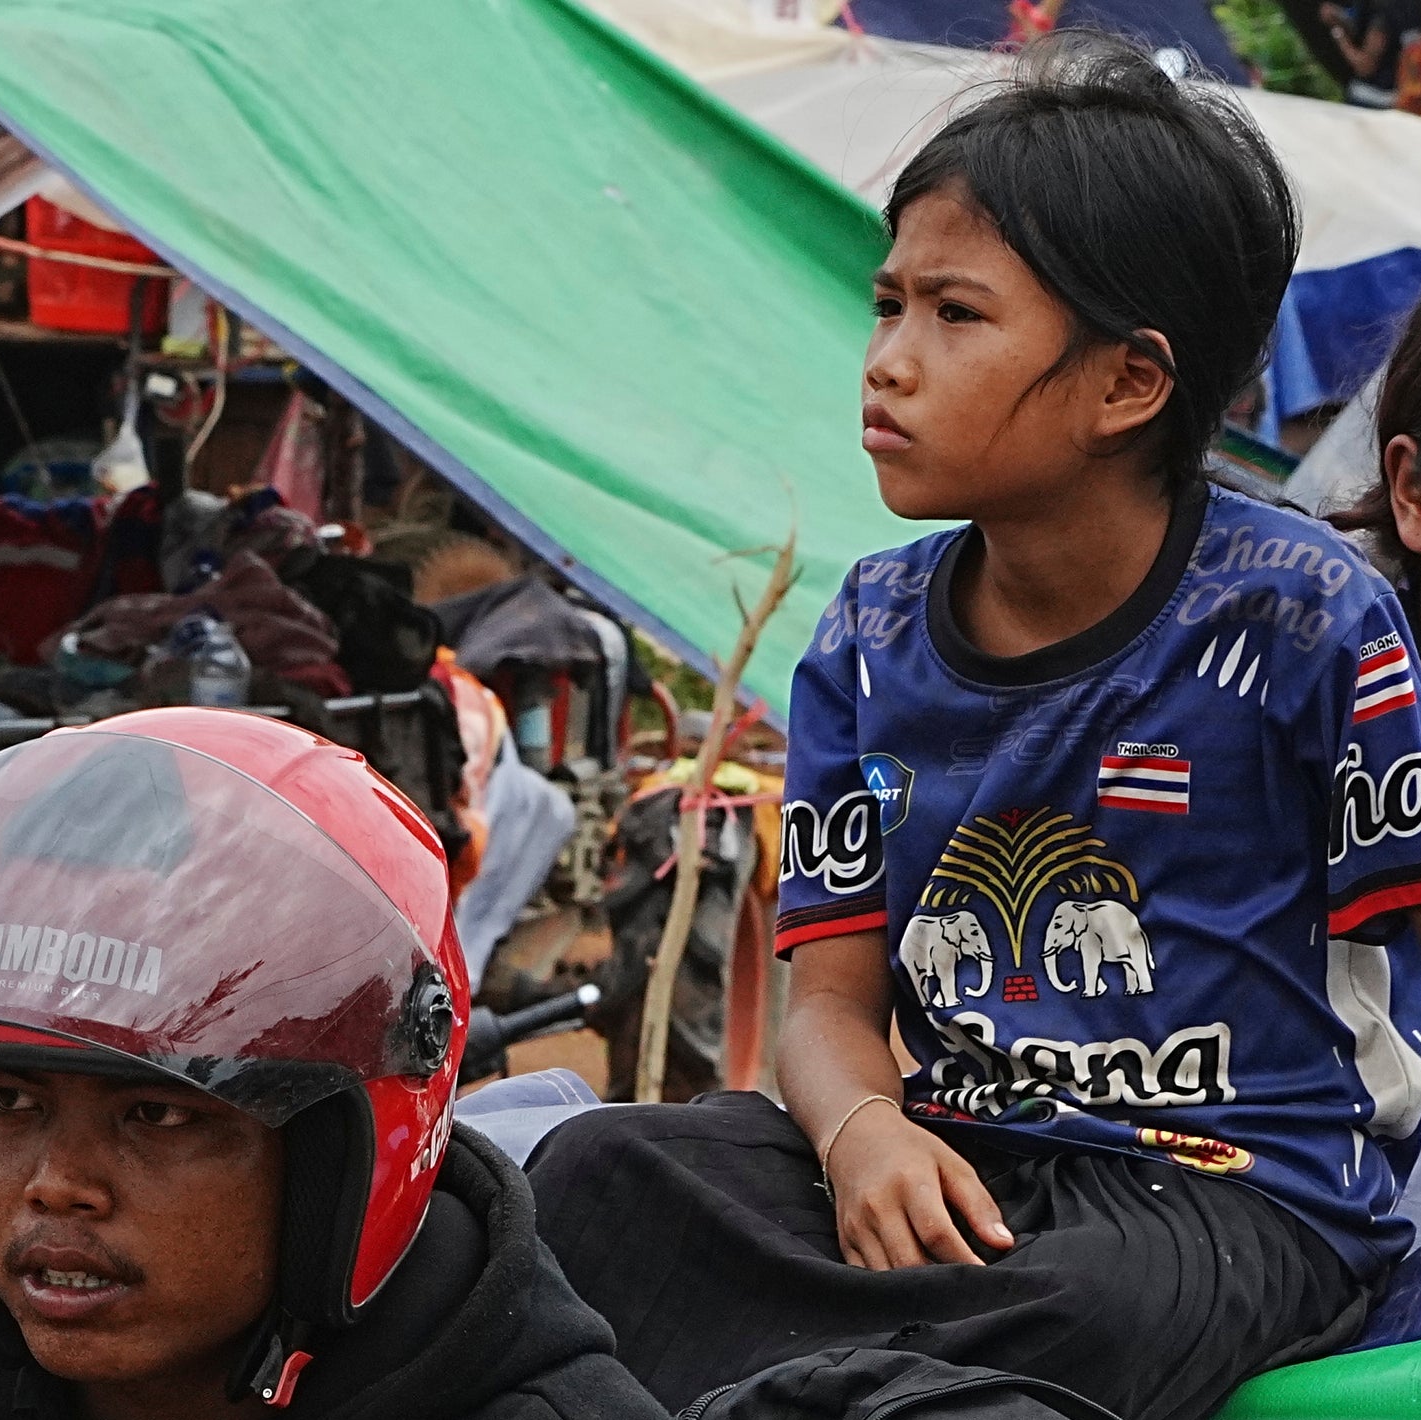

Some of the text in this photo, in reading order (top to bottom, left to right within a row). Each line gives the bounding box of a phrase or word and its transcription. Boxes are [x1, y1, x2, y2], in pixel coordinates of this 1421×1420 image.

[1189, 525, 1354, 598] Chang
[1117, 741, 1179, 758] THAILAND
[60, 986, 102, 1002] BER
